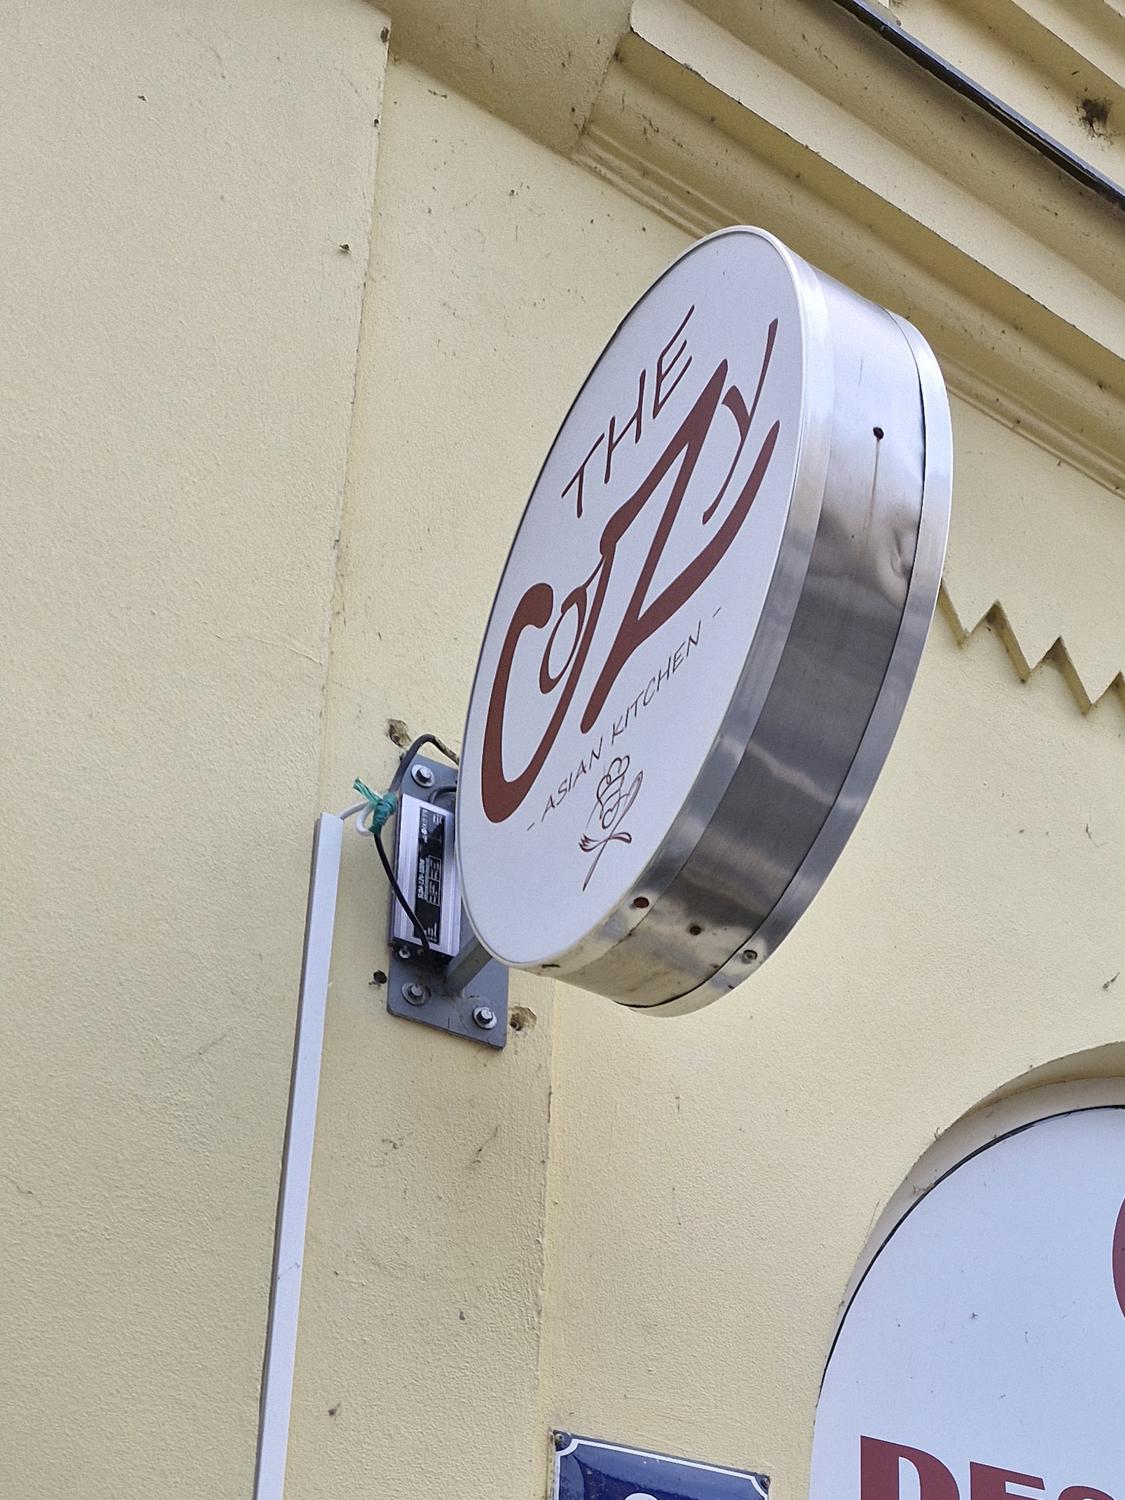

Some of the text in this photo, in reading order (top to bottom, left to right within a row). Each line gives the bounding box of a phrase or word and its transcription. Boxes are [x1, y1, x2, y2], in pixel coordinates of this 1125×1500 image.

[561, 304, 694, 519] THE
[542, 619, 702, 820] ASIAN KITCHEN
